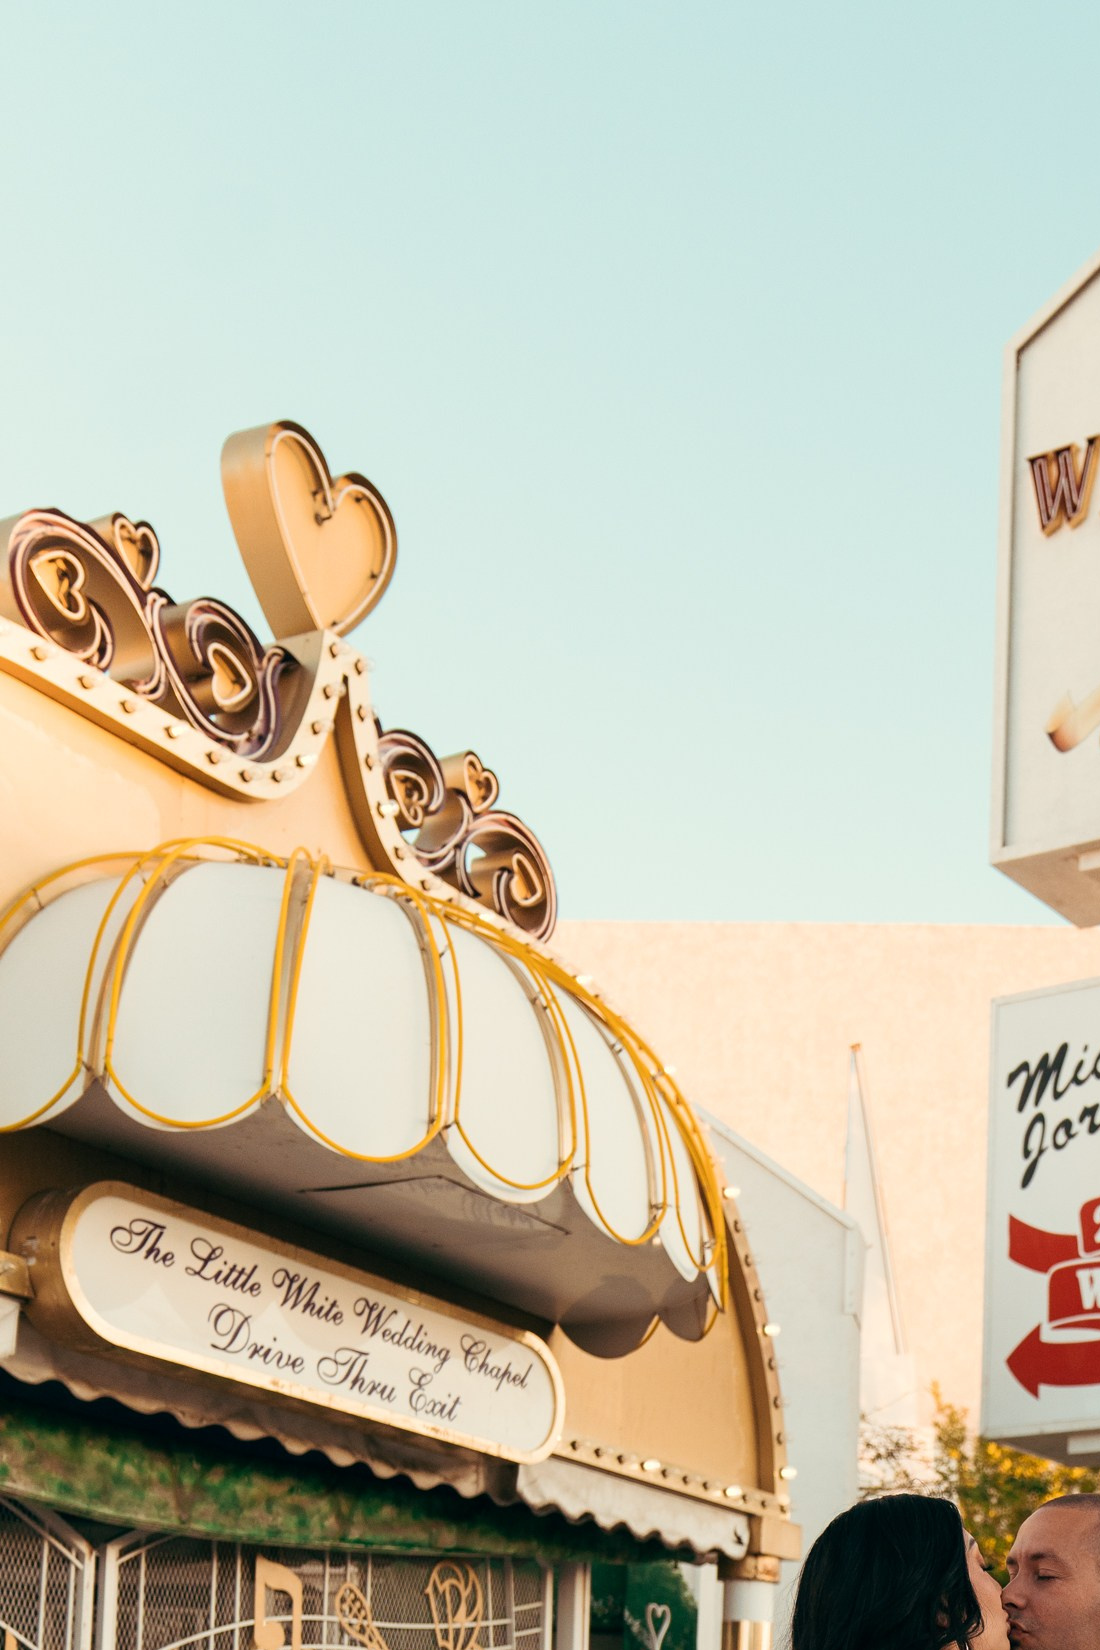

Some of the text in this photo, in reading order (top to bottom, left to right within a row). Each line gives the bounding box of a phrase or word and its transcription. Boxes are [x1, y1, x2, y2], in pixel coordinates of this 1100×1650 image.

[109, 1217, 535, 1391] The Little White Wedding Chapel
[207, 1302, 462, 1422] Drive Thru Exit
